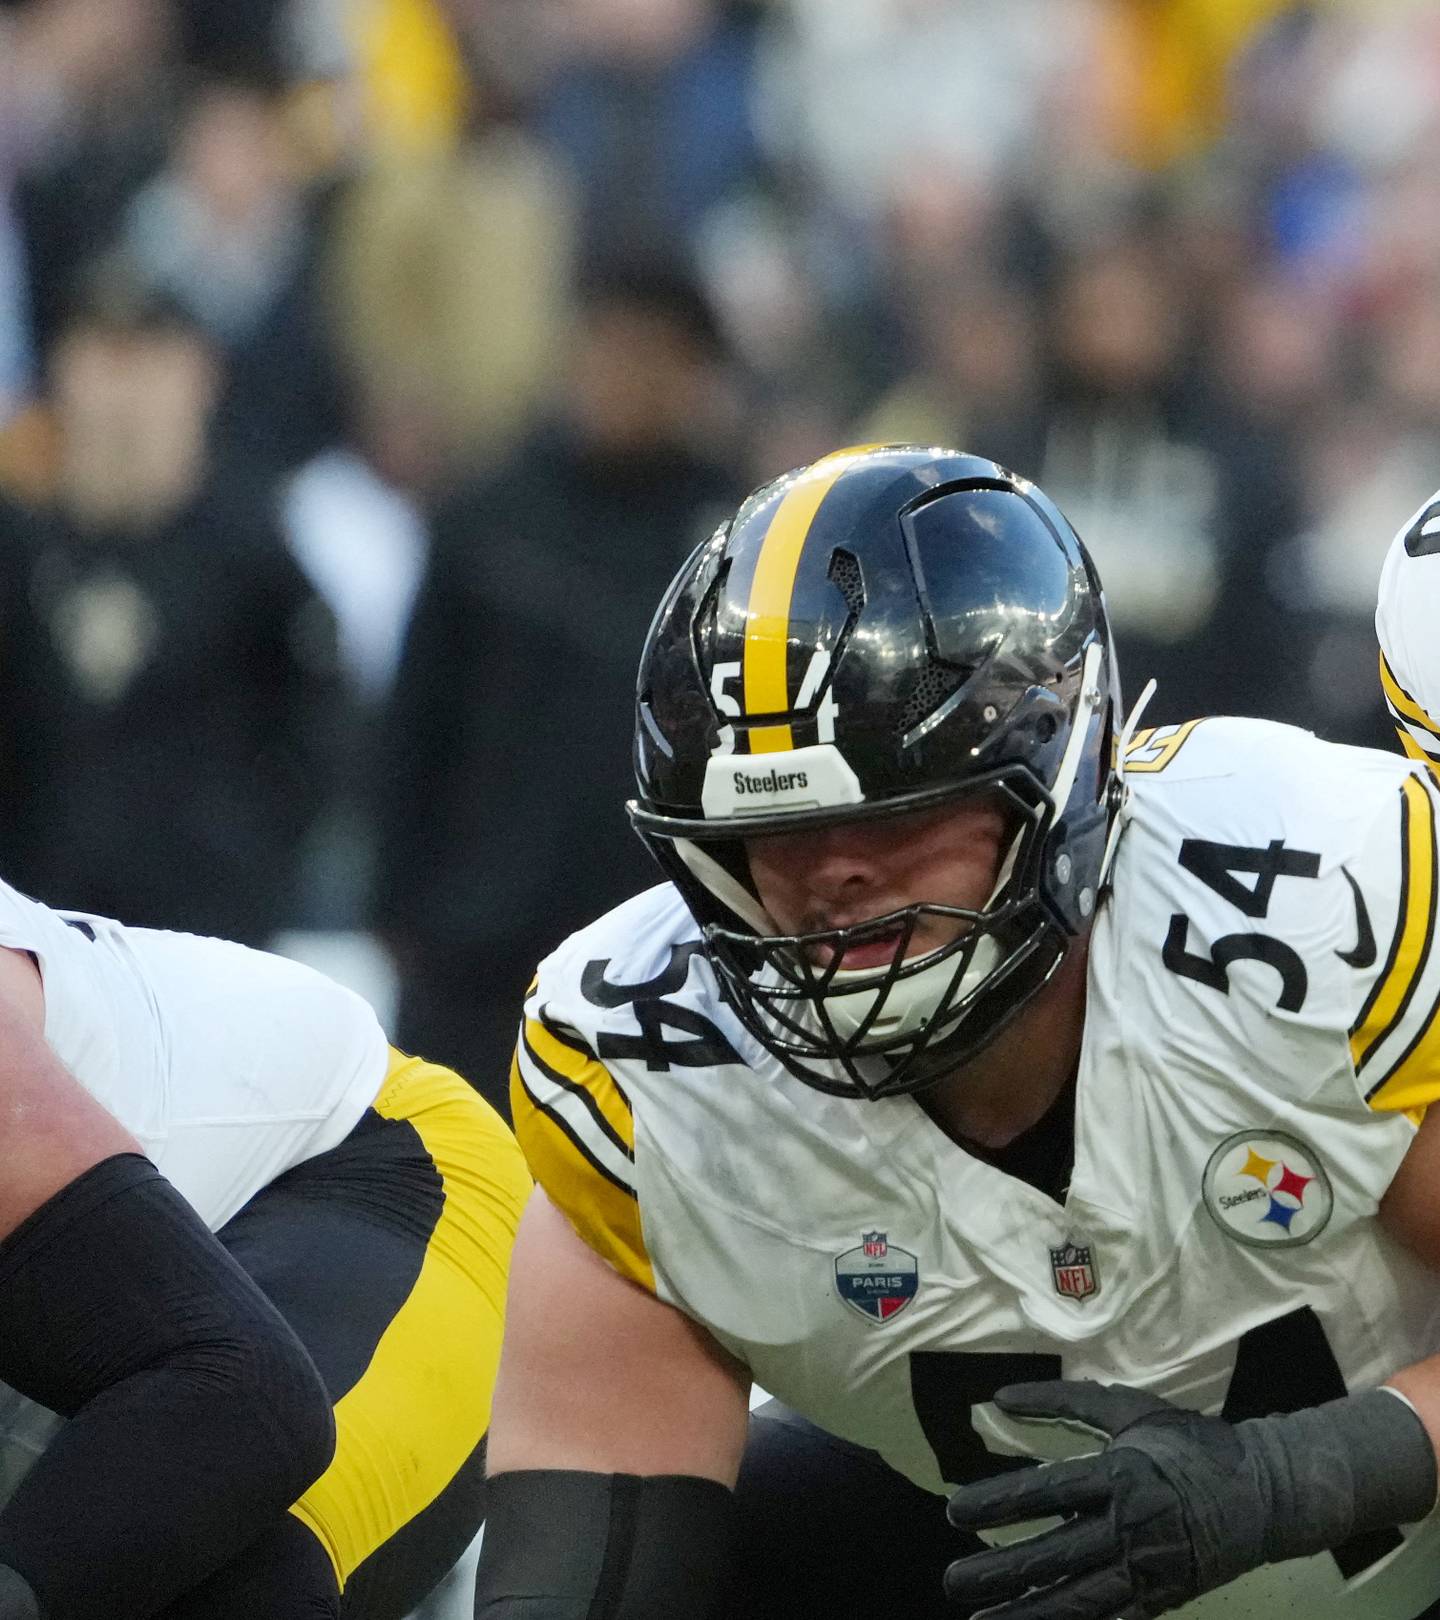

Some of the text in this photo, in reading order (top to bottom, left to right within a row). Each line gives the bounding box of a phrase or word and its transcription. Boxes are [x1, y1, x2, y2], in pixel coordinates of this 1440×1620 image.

[733, 769, 808, 795] Steelers
[1162, 839, 1321, 1013] 54
[852, 1276, 903, 1288] PARIS
